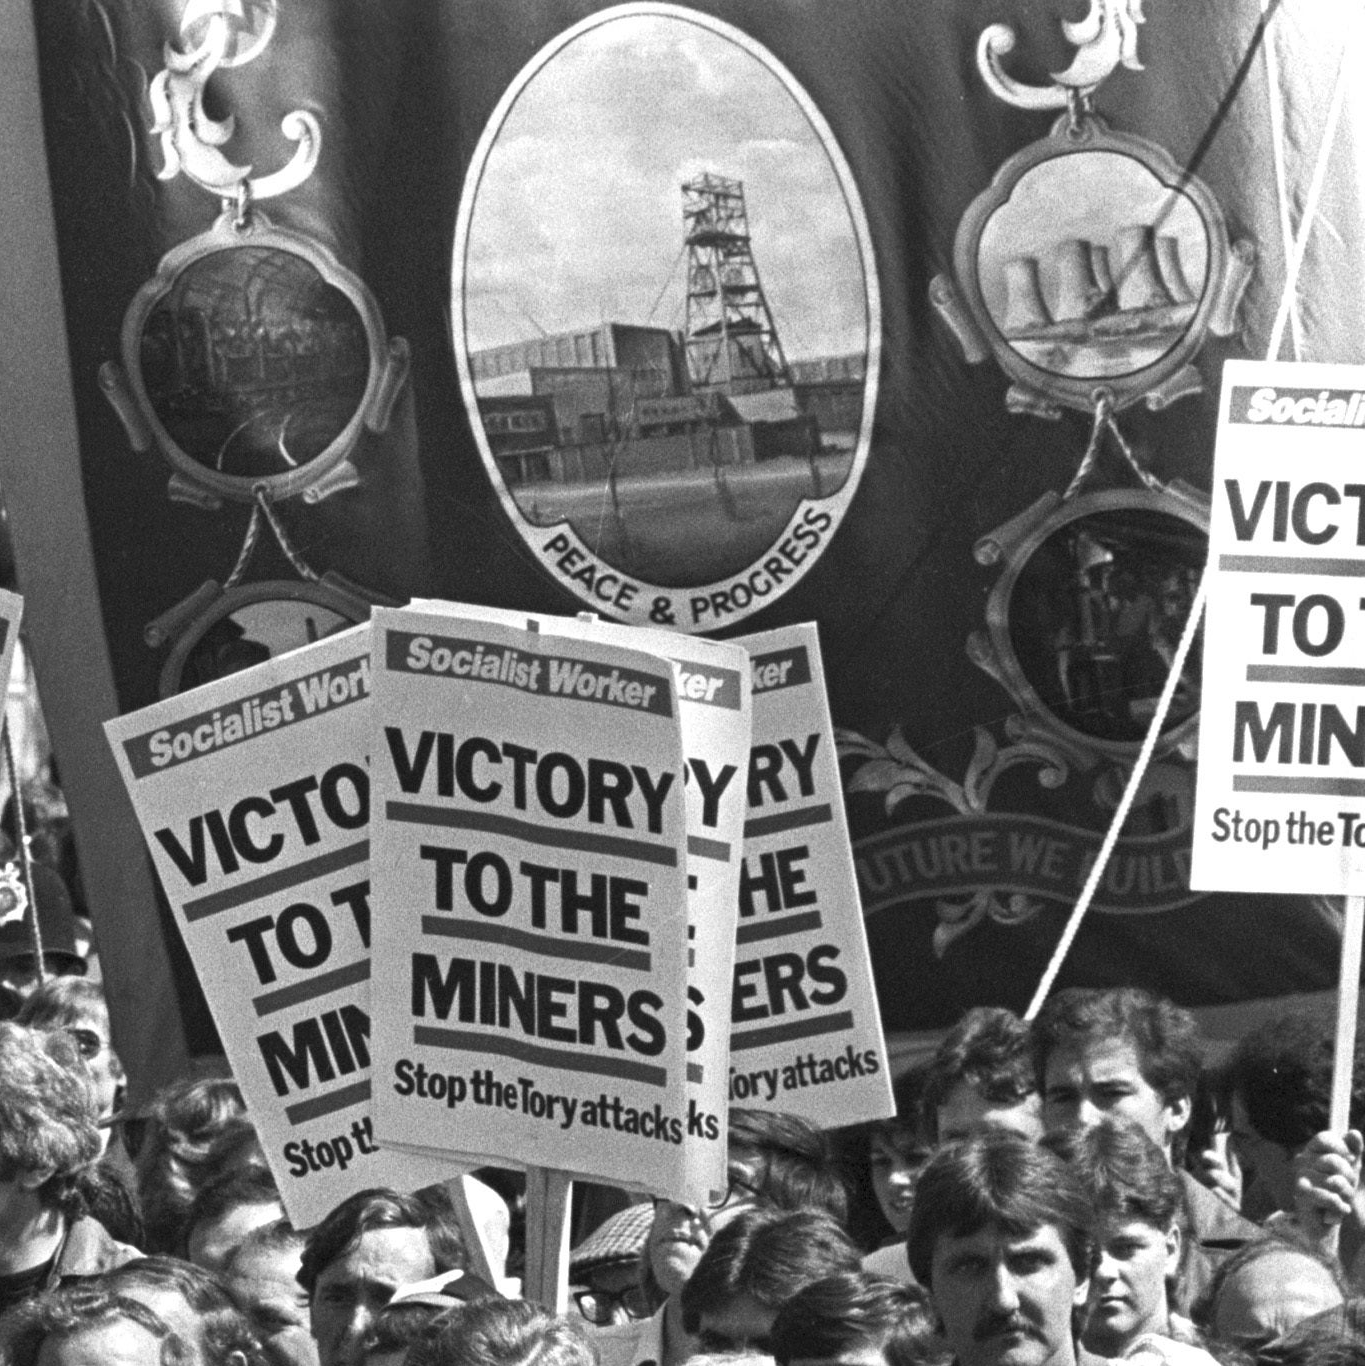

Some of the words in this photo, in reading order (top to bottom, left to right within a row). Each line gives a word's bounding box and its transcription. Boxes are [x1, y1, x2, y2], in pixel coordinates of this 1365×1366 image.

[1247, 387, 1365, 425] Sociali
[1225, 479, 1365, 546] VICT
[543, 533, 640, 613] PEACE
[649, 597, 676, 625] &
[691, 508, 832, 623] PROGRESS
[1251, 593, 1345, 657] TO
[407, 637, 541, 690] Socialist
[549, 660, 656, 707] Worker
[673, 662, 724, 701] ker
[751, 658, 793, 688] ker
[150, 689, 294, 766] Socialist
[298, 661, 370, 713] Work
[1233, 701, 1365, 767] MIN
[385, 727, 674, 834] VICTORY
[154, 763, 370, 886] VICTO
[1212, 808, 1280, 850] Stop
[1286, 811, 1334, 845] the
[1338, 812, 1365, 848] To
[420, 845, 512, 917] TO
[520, 861, 649, 946] THE
[739, 845, 817, 917] HE
[861, 831, 999, 893] UTURE
[1008, 832, 1069, 879] WE
[226, 903, 332, 985] TO
[412, 953, 666, 1056] MINERS
[731, 945, 847, 1023] ERS
[258, 1005, 370, 1096] MIN
[782, 1045, 879, 1090] attacks
[394, 1059, 466, 1108] Stop
[470, 1071, 517, 1110] the
[518, 1080, 577, 1129] Tory
[581, 1098, 682, 1144] attacks
[284, 1136, 353, 1177] Stop
